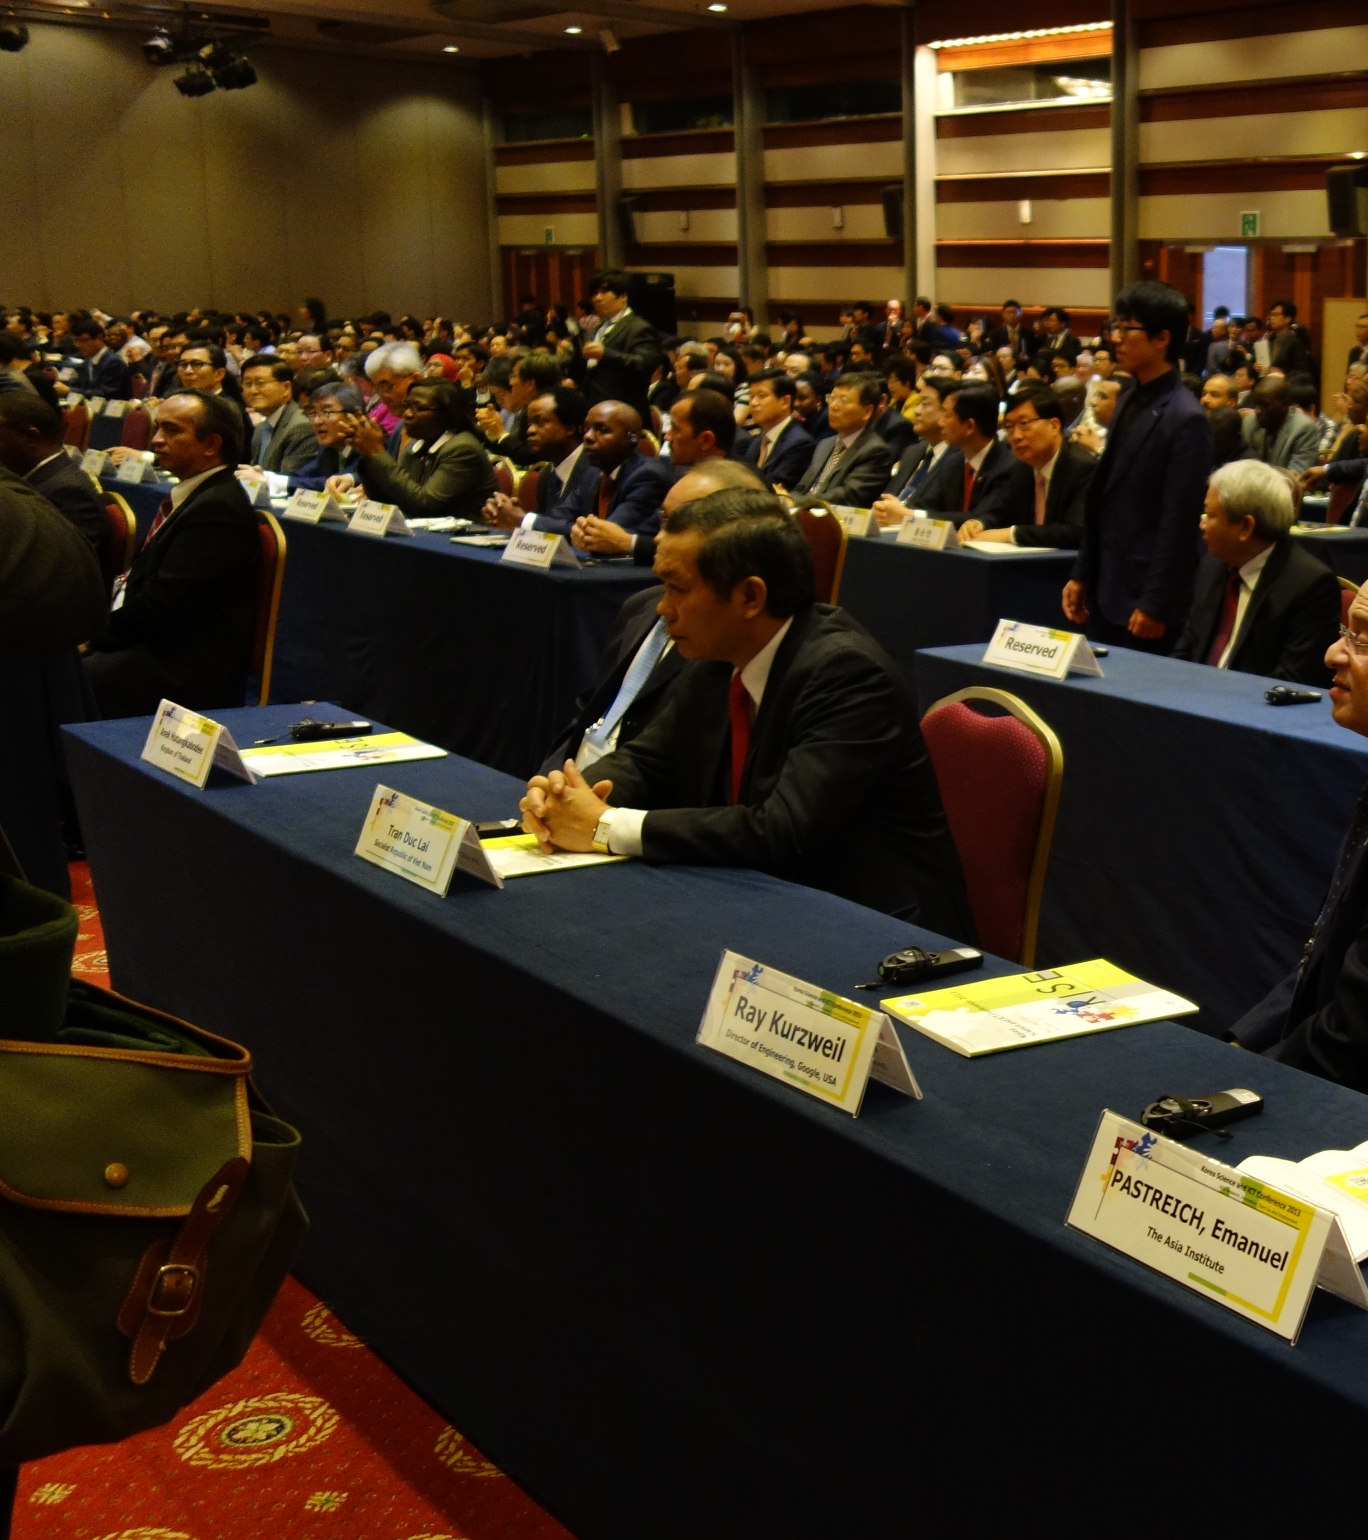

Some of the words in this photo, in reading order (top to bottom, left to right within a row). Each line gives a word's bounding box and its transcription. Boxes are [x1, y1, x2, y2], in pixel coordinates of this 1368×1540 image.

[515, 540, 548, 554] Reserved
[1004, 637, 1059, 658] Reserved
[387, 824, 403, 840] Tran
[403, 832, 417, 846] Duc
[417, 837, 429, 852] Lai
[1023, 970, 1106, 1008] RISE
[734, 995, 766, 1033] Ray
[768, 1009, 845, 1062] Kurzweil
[726, 1029, 749, 1046] Director
[749, 1038, 758, 1050] of
[758, 1043, 796, 1069] Engineering,
[796, 1060, 821, 1080] Google,
[823, 1073, 837, 1086] USA
[1201, 1166, 1215, 1176] Korea
[1216, 1172, 1235, 1186] Science
[1236, 1182, 1246, 1190] and
[1247, 1187, 1255, 1195] ICT
[1256, 1191, 1286, 1209] Conference
[1287, 1205, 1300, 1216] 2013
[1110, 1168, 1206, 1236] PASTREICH,
[1210, 1218, 1288, 1271] Emanuel
[1146, 1226, 1163, 1242] The
[1164, 1235, 1183, 1253] Asia
[1184, 1245, 1225, 1274] Institute
